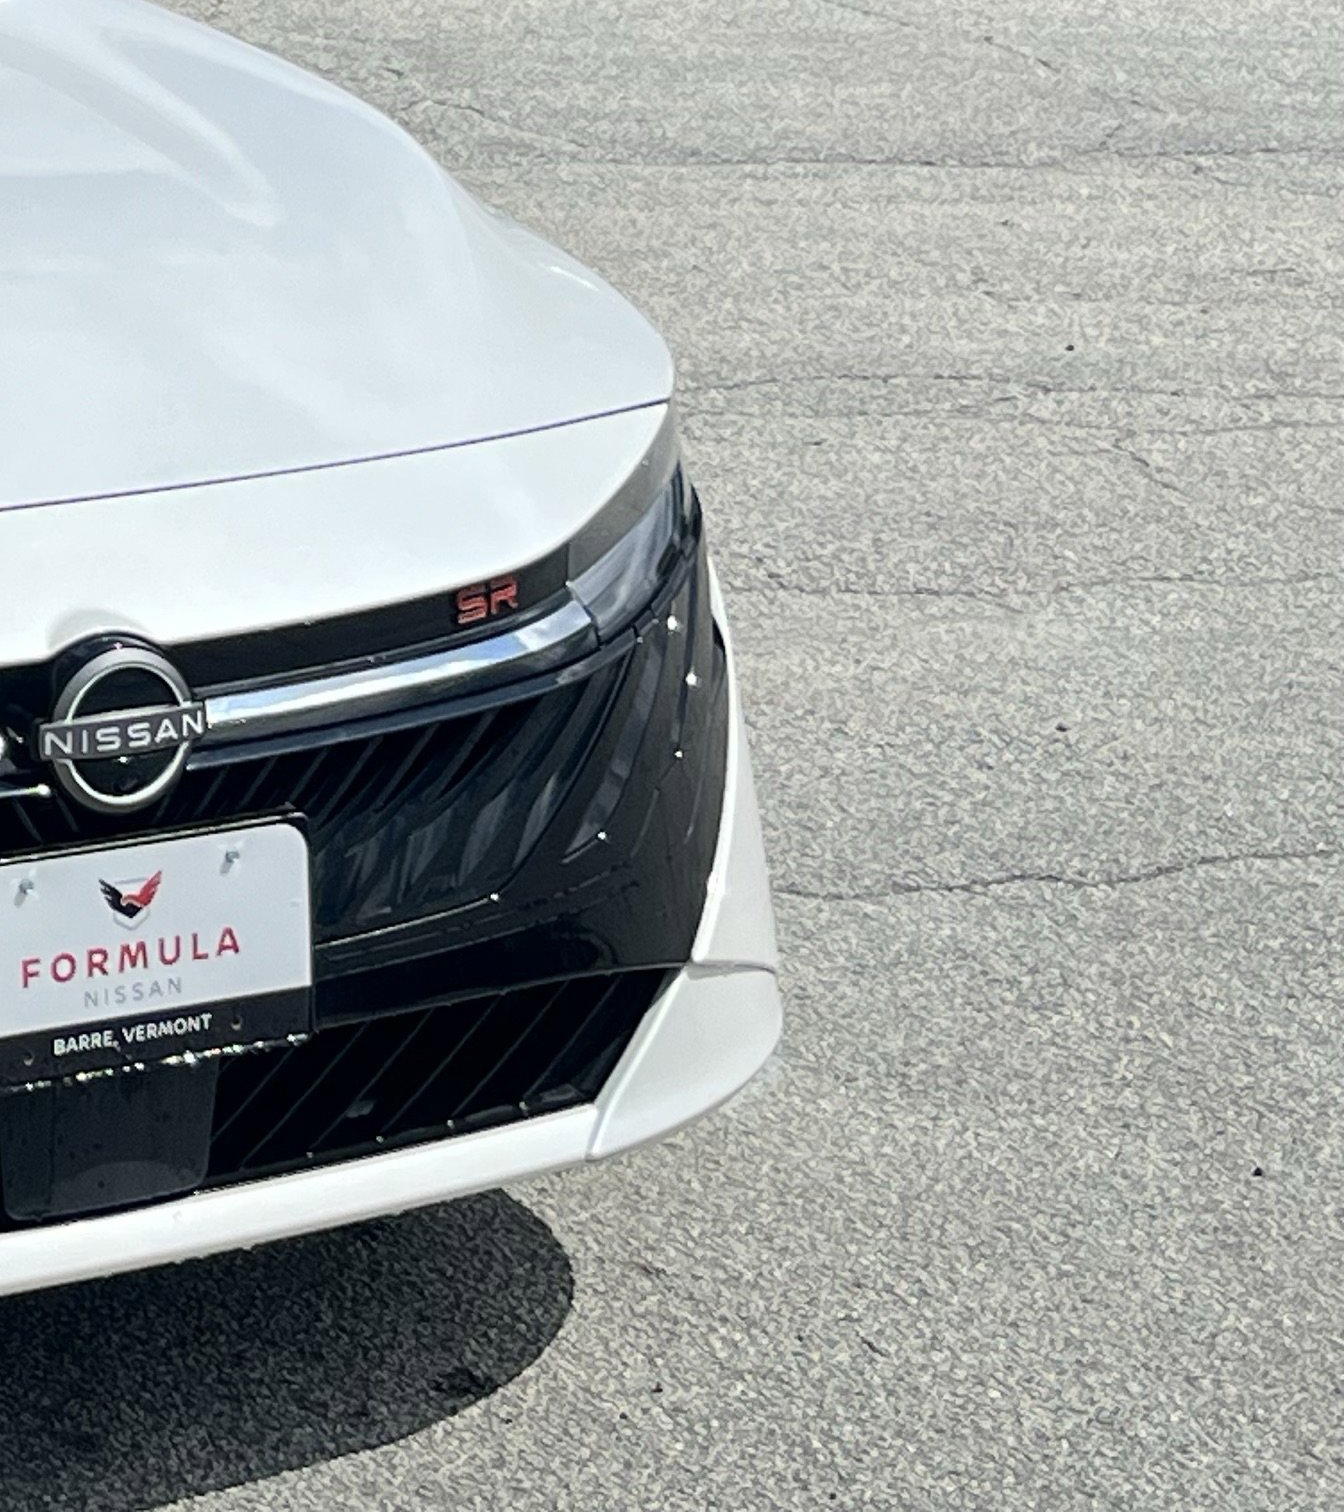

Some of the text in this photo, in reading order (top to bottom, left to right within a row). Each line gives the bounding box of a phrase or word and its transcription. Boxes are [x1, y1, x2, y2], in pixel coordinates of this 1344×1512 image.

[456, 574, 519, 624] SR
[43, 710, 205, 756] NISSAN
[20, 926, 241, 989] FORMULA
[83, 976, 183, 1009] NISSAN
[52, 1013, 213, 1058] BARRE, VERMONT
